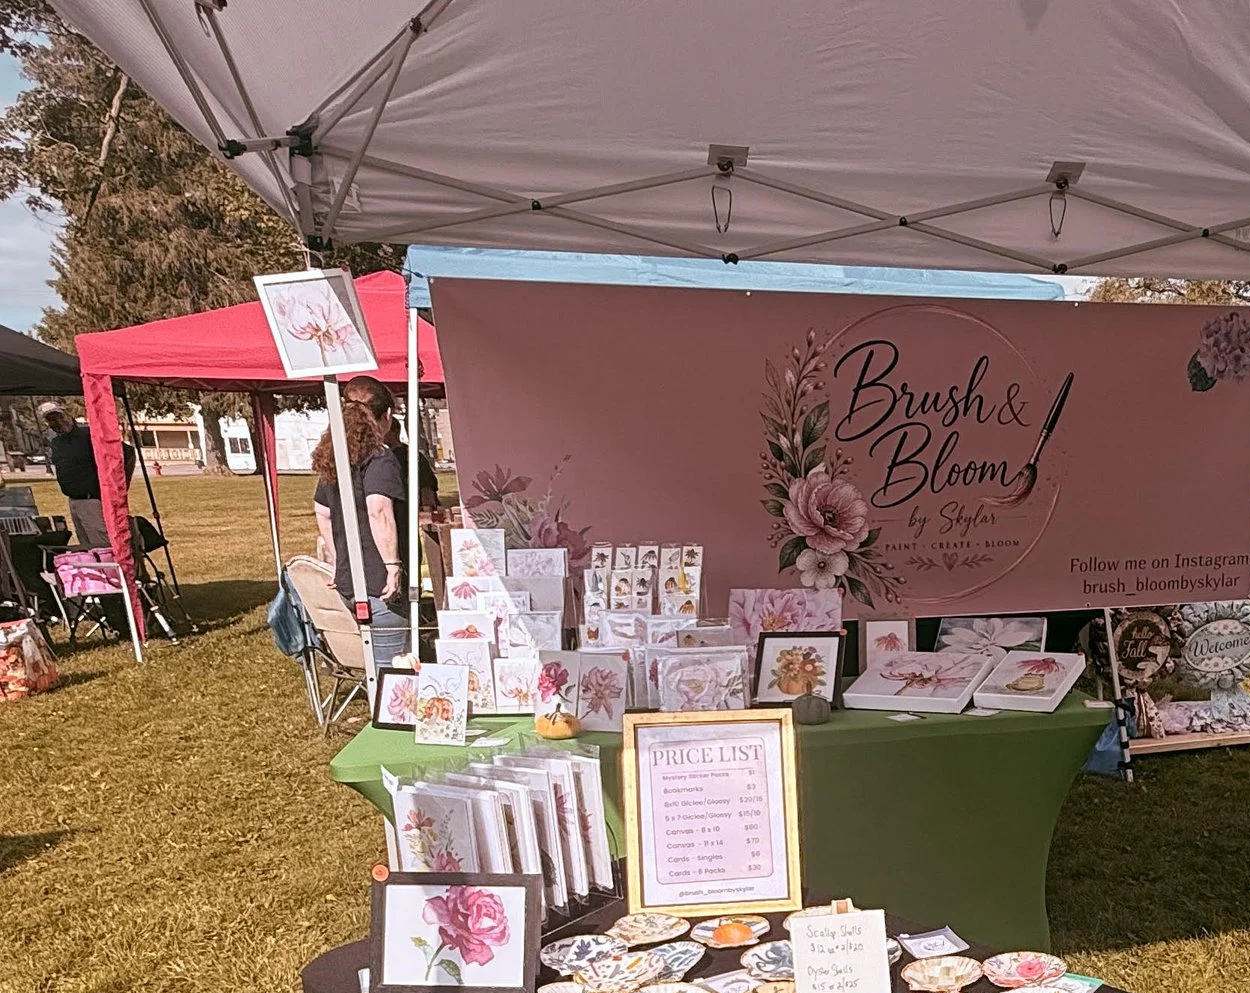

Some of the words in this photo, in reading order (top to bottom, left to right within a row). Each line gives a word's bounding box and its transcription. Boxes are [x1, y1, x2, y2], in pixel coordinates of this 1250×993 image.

[833, 340, 1000, 442] Brush
[996, 382, 1032, 427] &
[868, 422, 1023, 509] Bloom
[908, 505, 931, 539] by
[939, 501, 997, 537] Skylar
[885, 542, 917, 551] PAINT
[931, 541, 971, 550] CREATE
[985, 540, 1020, 548] BLOOM
[1070, 555, 1119, 574] Follow
[1123, 557, 1147, 571] me
[1150, 555, 1170, 569] on
[1082, 573, 1241, 597] brush_bloombyskylar
[1132, 625, 1154, 640] hello
[1122, 640, 1148, 660] Fall
[1188, 635, 1250, 657] Welcome
[652, 746, 713, 767] PRICE
[719, 744, 763, 763] LIST
[663, 786, 704, 795] Bookmarks
[666, 842, 695, 850] Canvas
[697, 854, 723, 862] Singles
[668, 869, 691, 877] Cards
[704, 866, 726, 874] Packs
